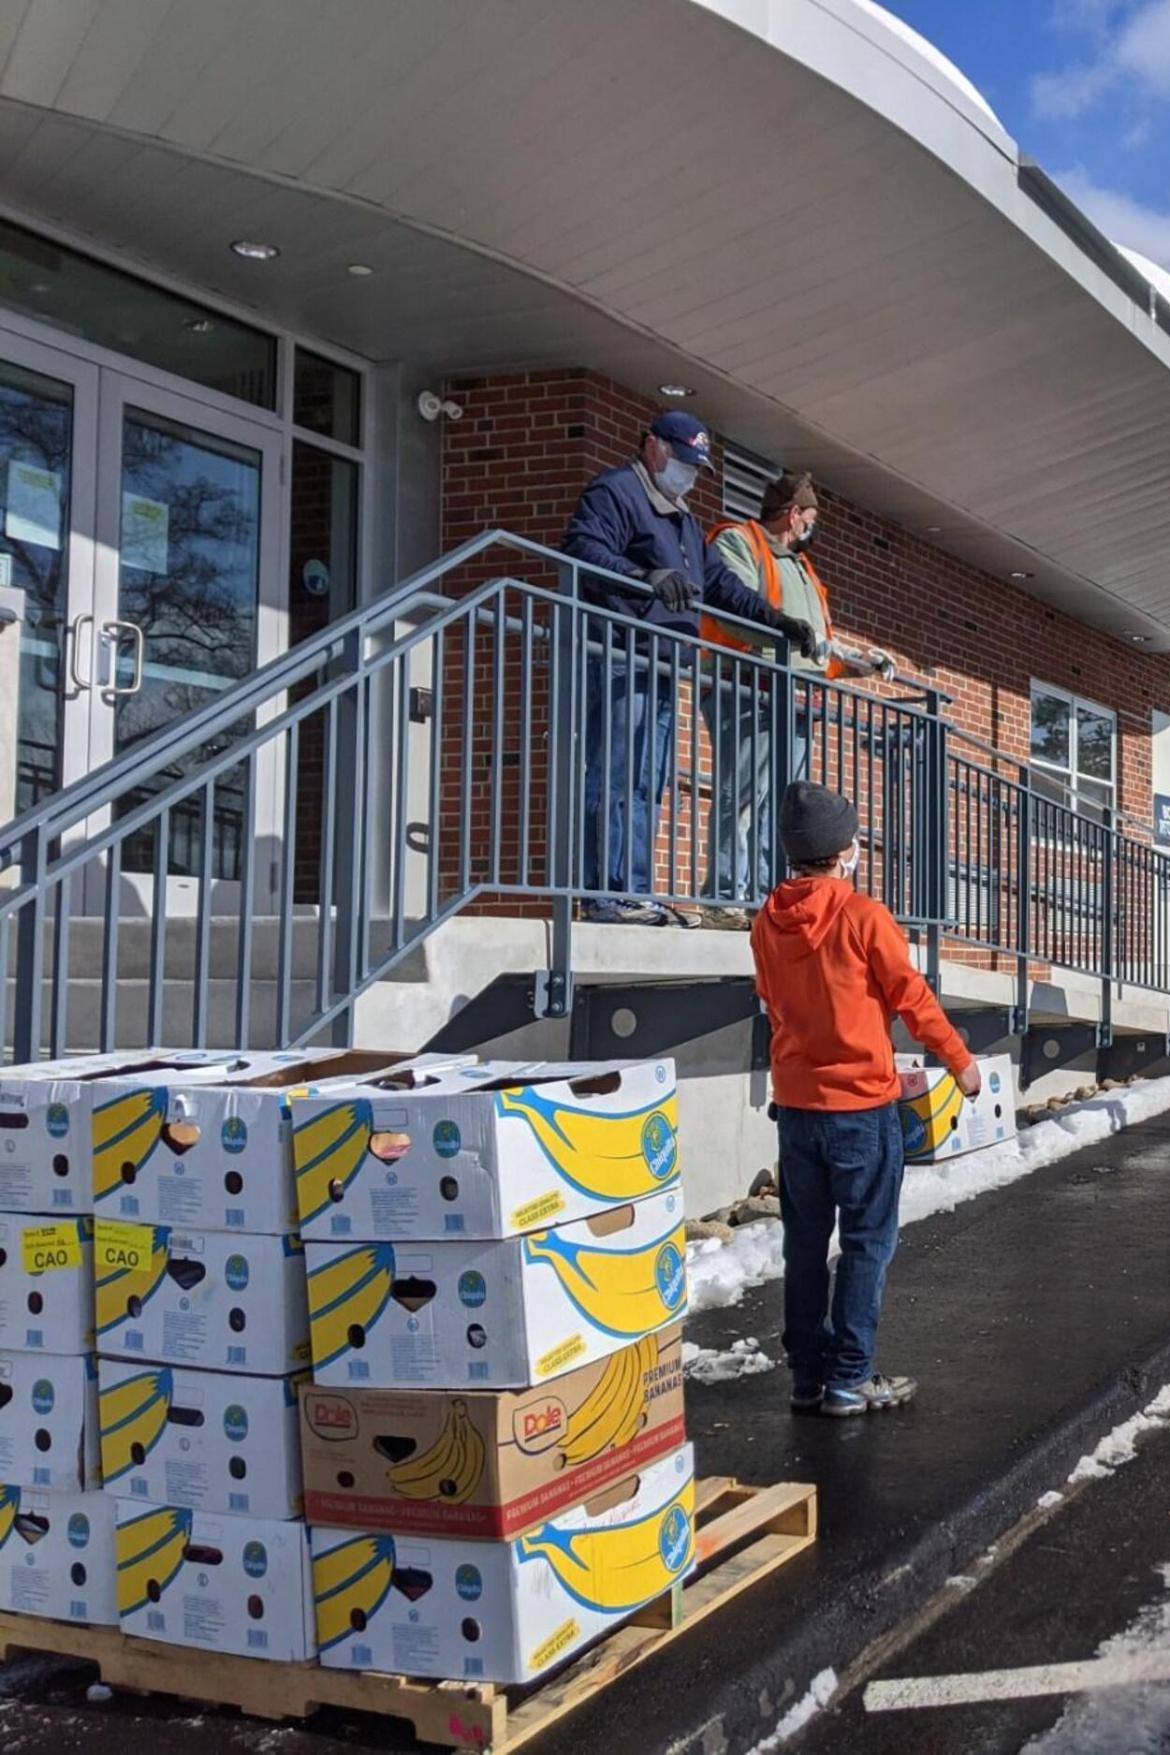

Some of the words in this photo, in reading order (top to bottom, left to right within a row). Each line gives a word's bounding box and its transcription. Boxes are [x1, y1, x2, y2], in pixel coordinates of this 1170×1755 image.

[34, 1249, 69, 1268] CAO
[105, 1247, 140, 1267] CAO
[315, 1403, 351, 1423] Dole
[524, 1405, 561, 1436] Dole
